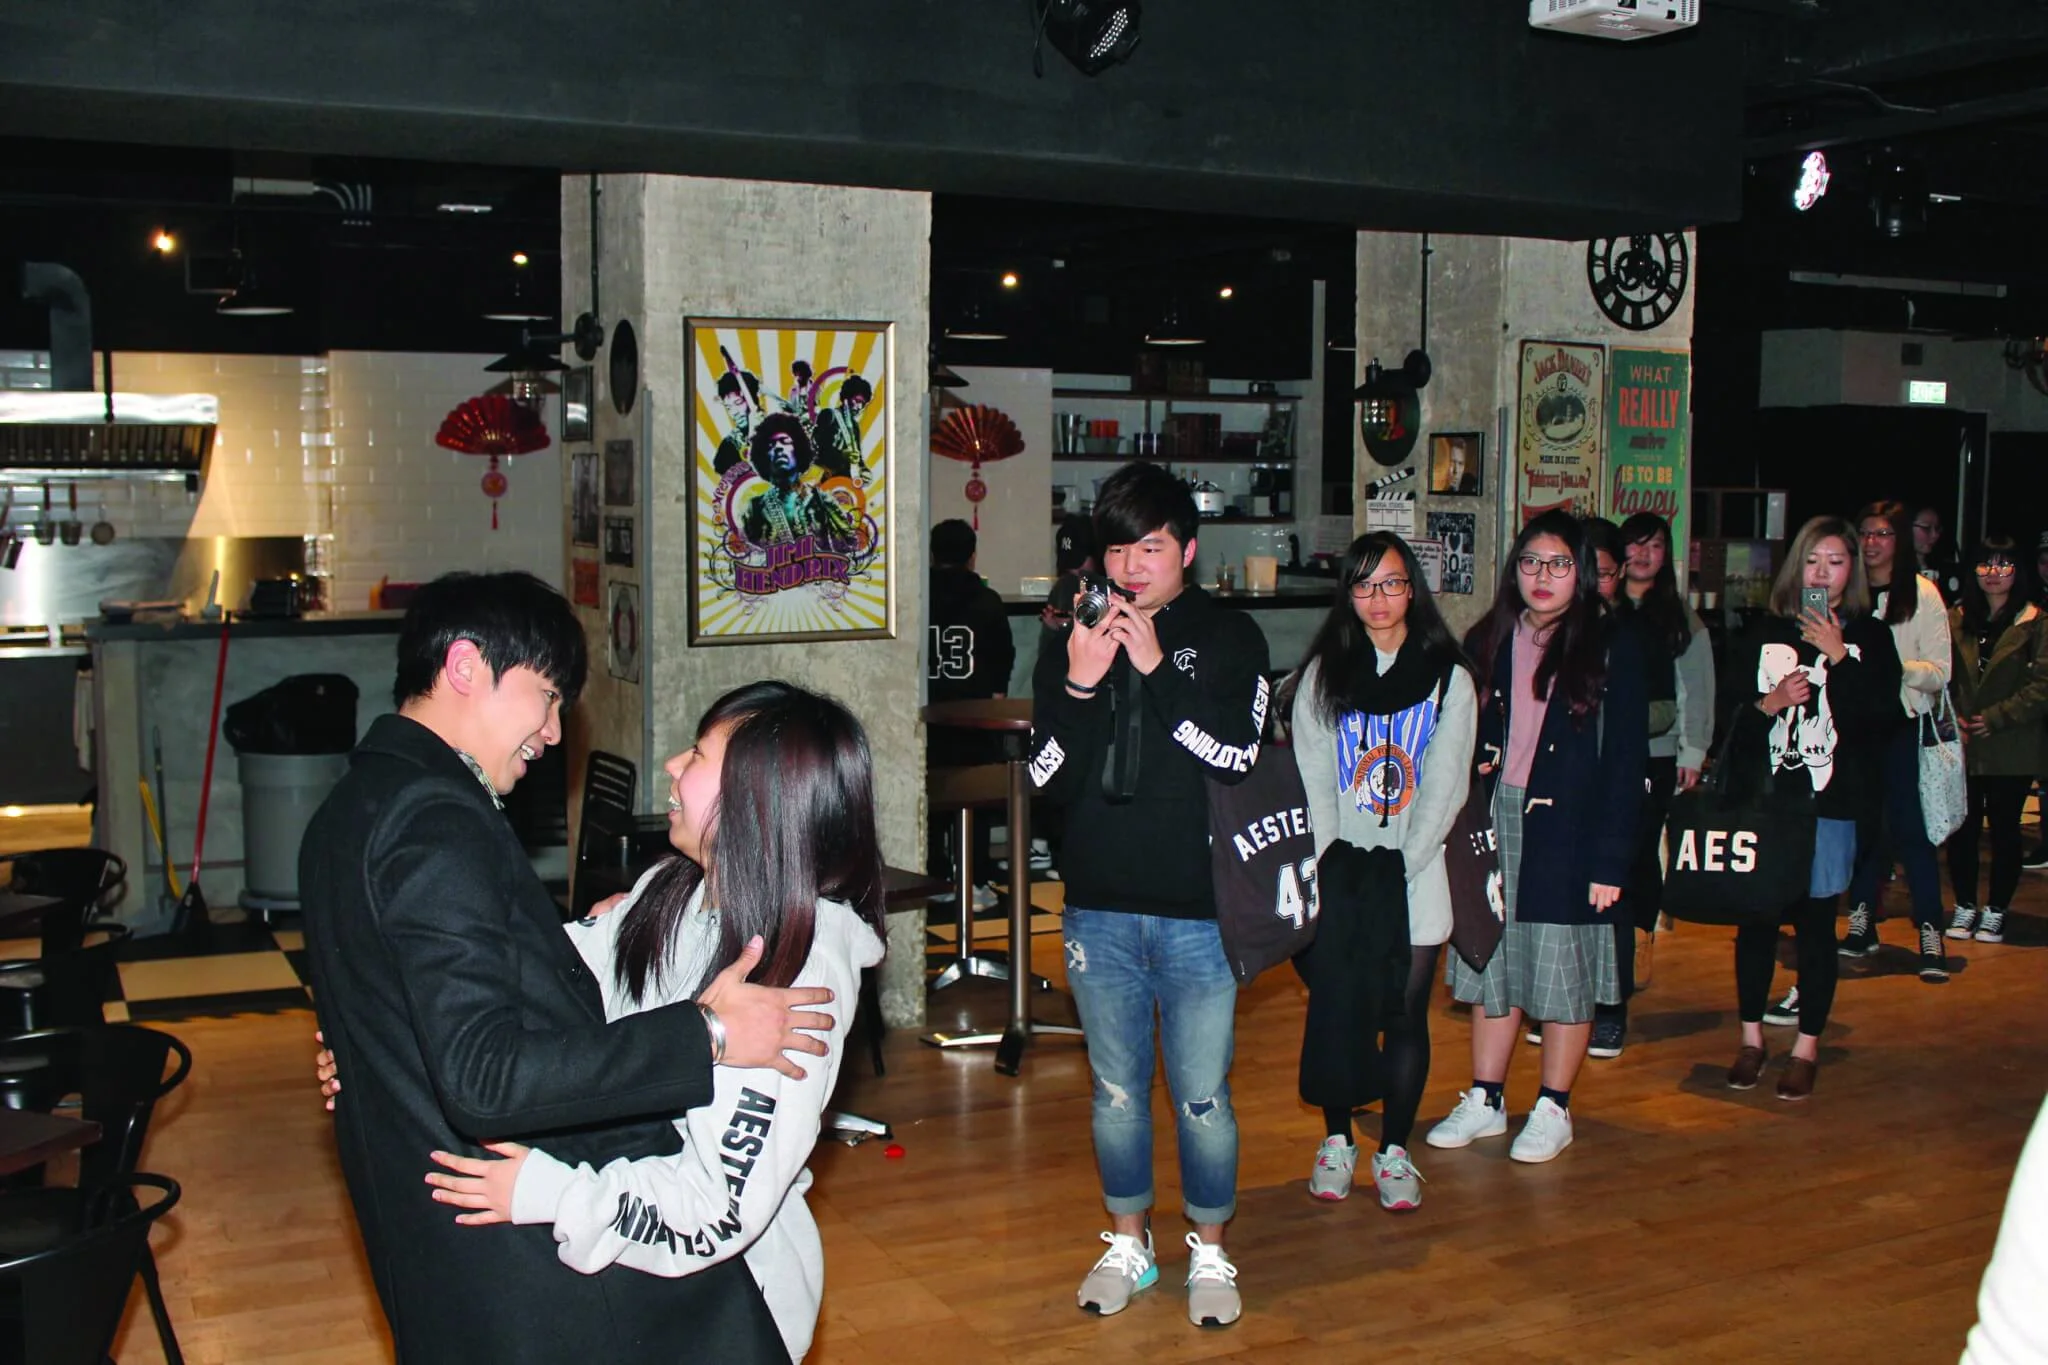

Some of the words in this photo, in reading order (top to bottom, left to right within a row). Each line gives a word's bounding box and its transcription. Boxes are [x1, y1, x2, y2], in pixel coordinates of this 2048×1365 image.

[1630, 365, 1672, 383] WHAT
[1619, 387, 1680, 429] REALLY
[1622, 466, 1634, 483] IS
[1637, 466, 1653, 483] TO
[1657, 466, 1672, 484] BE
[766, 535, 814, 570] JIMI
[735, 553, 850, 594] HENDRIX
[1676, 830, 1758, 872] AES
[1275, 854, 1320, 930] 43
